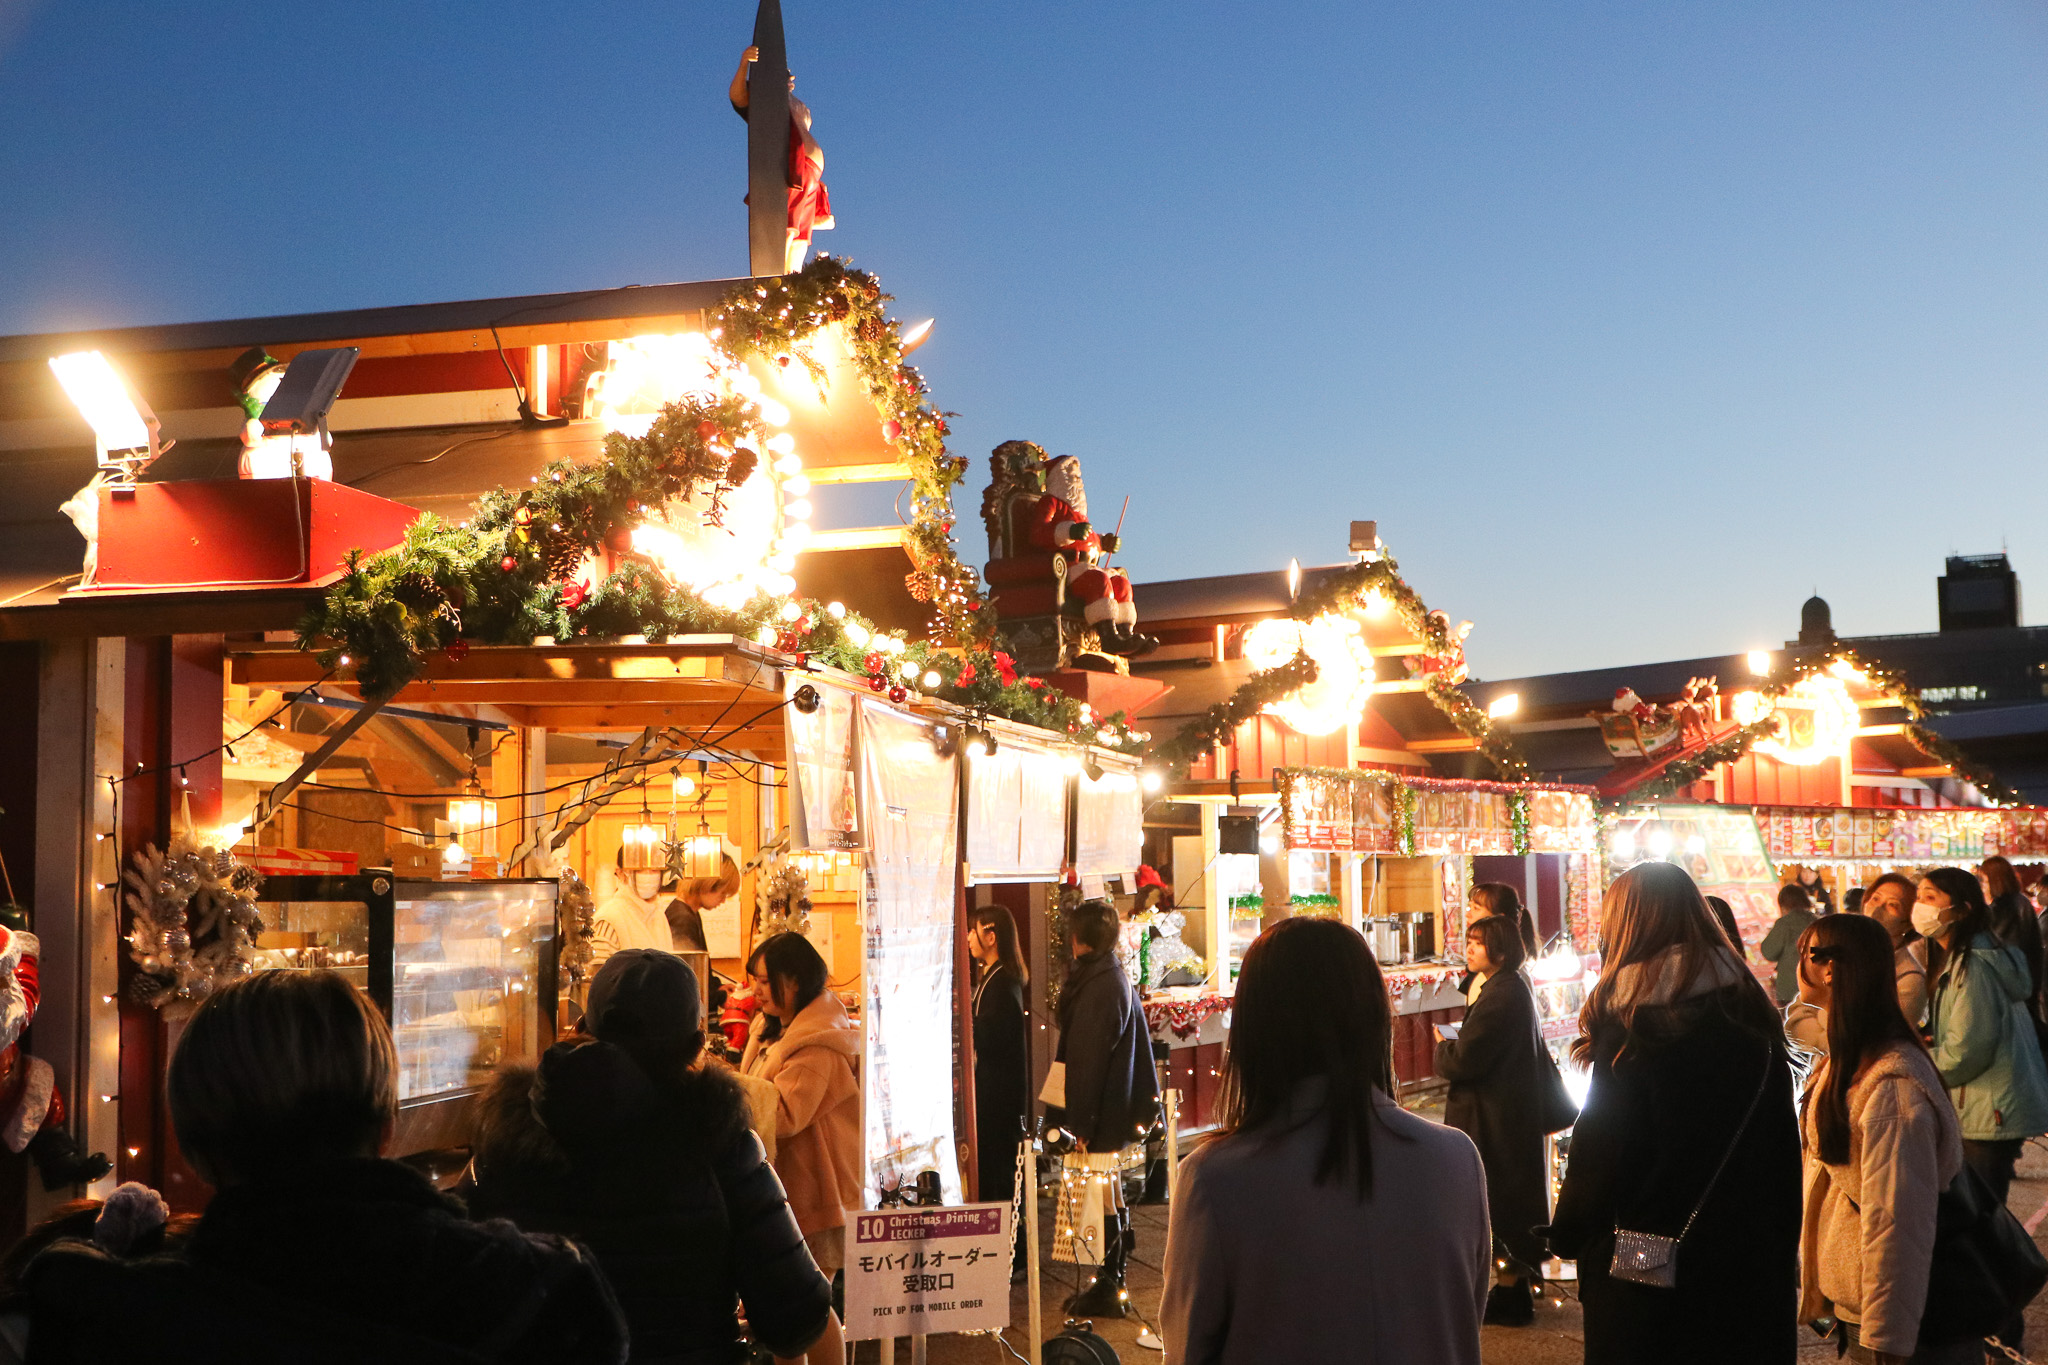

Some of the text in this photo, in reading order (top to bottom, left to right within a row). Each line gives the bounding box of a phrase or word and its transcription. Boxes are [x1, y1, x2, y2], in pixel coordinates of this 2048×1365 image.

[669, 508, 697, 535] Oyster
[860, 1212, 980, 1240] 10 Christmas Dining
[890, 1228, 925, 1240] LECKER
[859, 1247, 997, 1272] モバイルオーダー
[903, 1273, 954, 1293] 受取口
[873, 1299, 983, 1316] PICK UP FOR MOBILE ORDER
